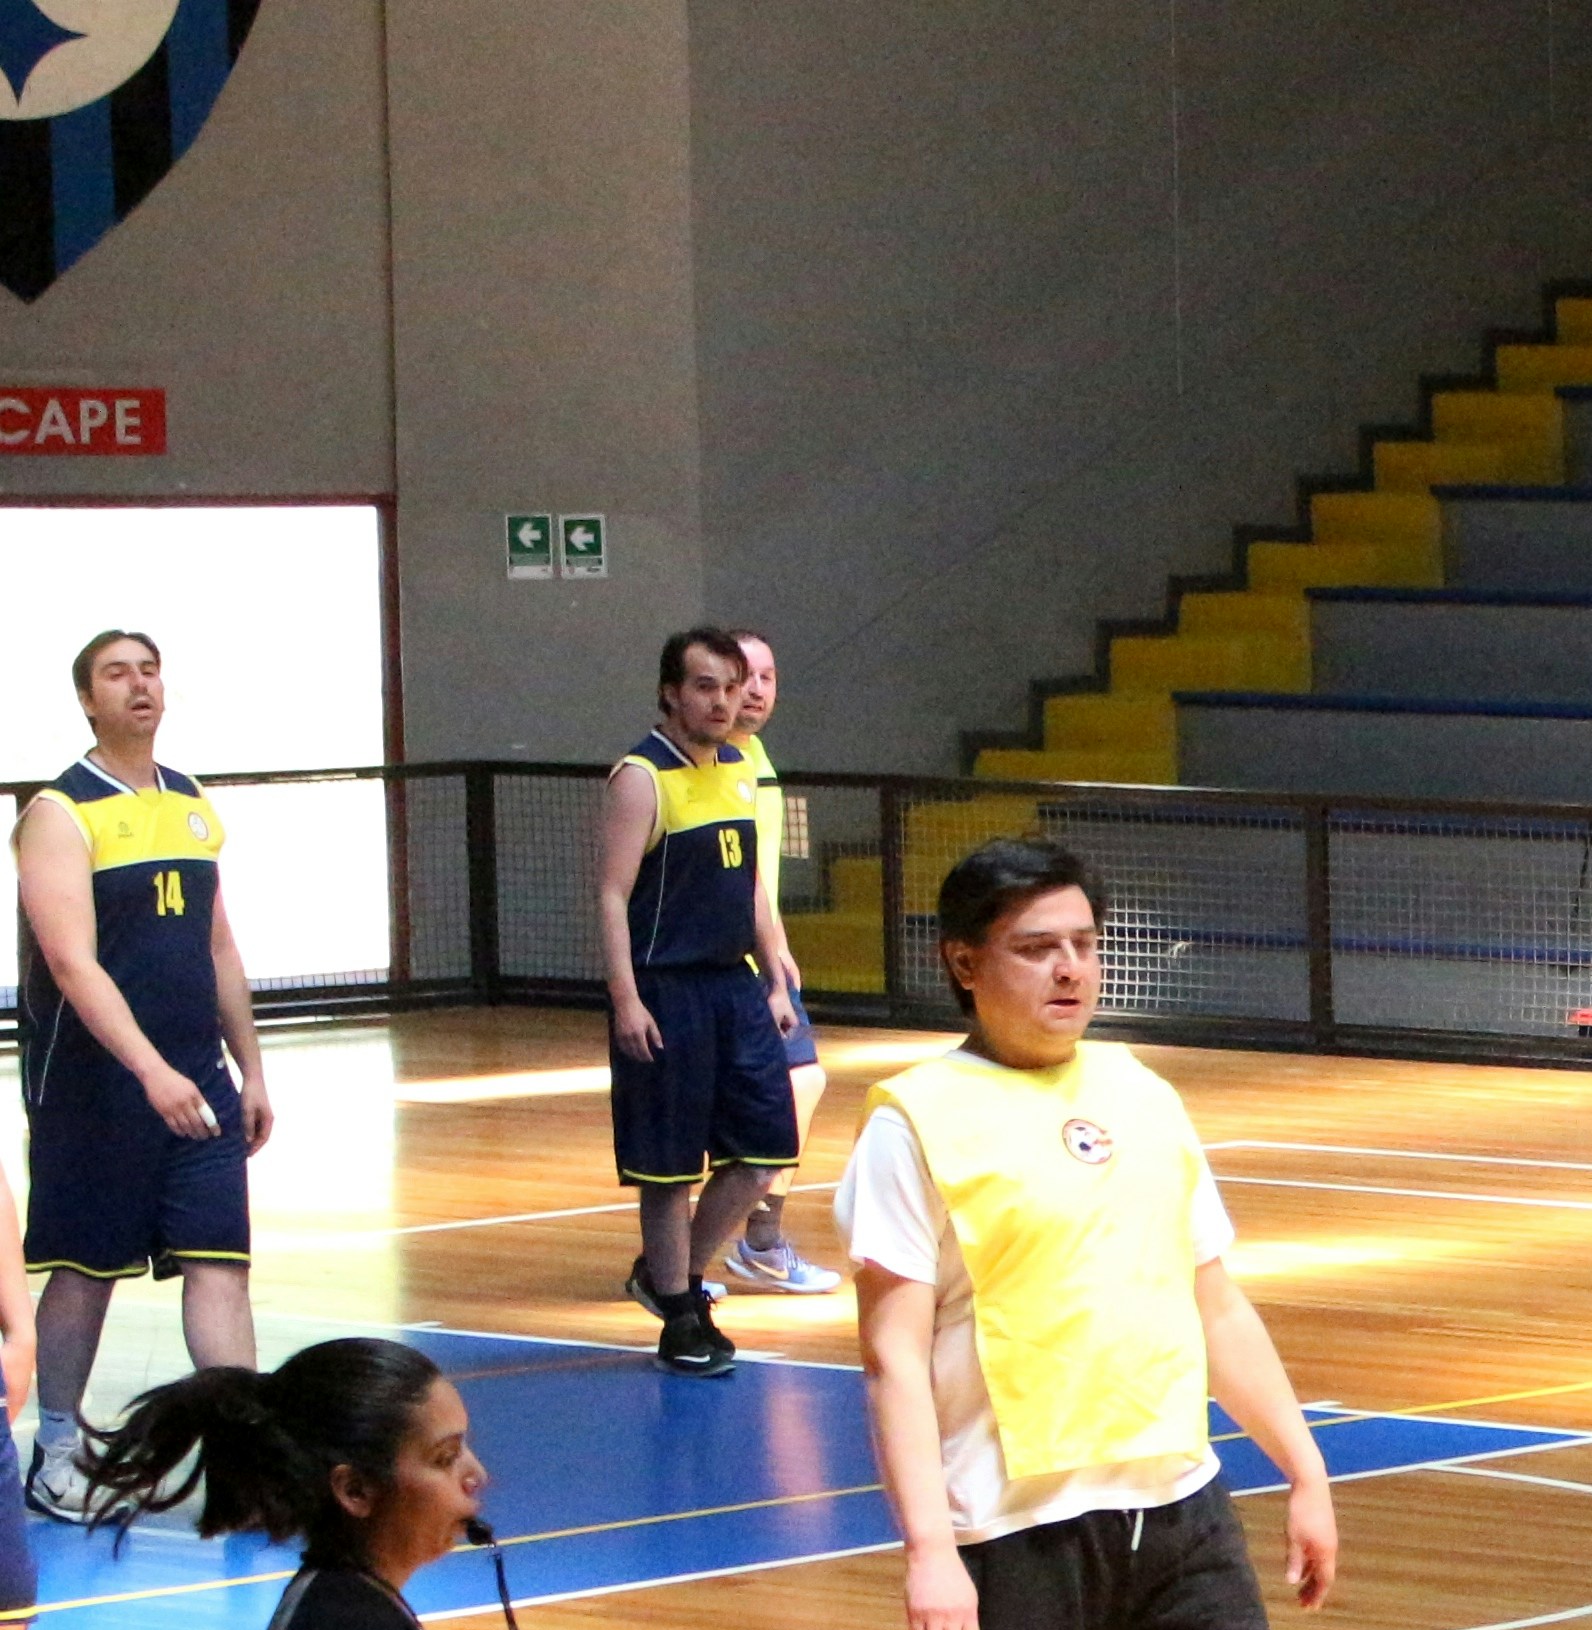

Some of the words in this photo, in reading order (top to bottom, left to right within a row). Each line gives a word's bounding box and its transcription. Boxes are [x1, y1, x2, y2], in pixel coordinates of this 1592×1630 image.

[0, 398, 142, 445] CAPE
[718, 828, 743, 869] 13
[153, 870, 185, 916] 14
